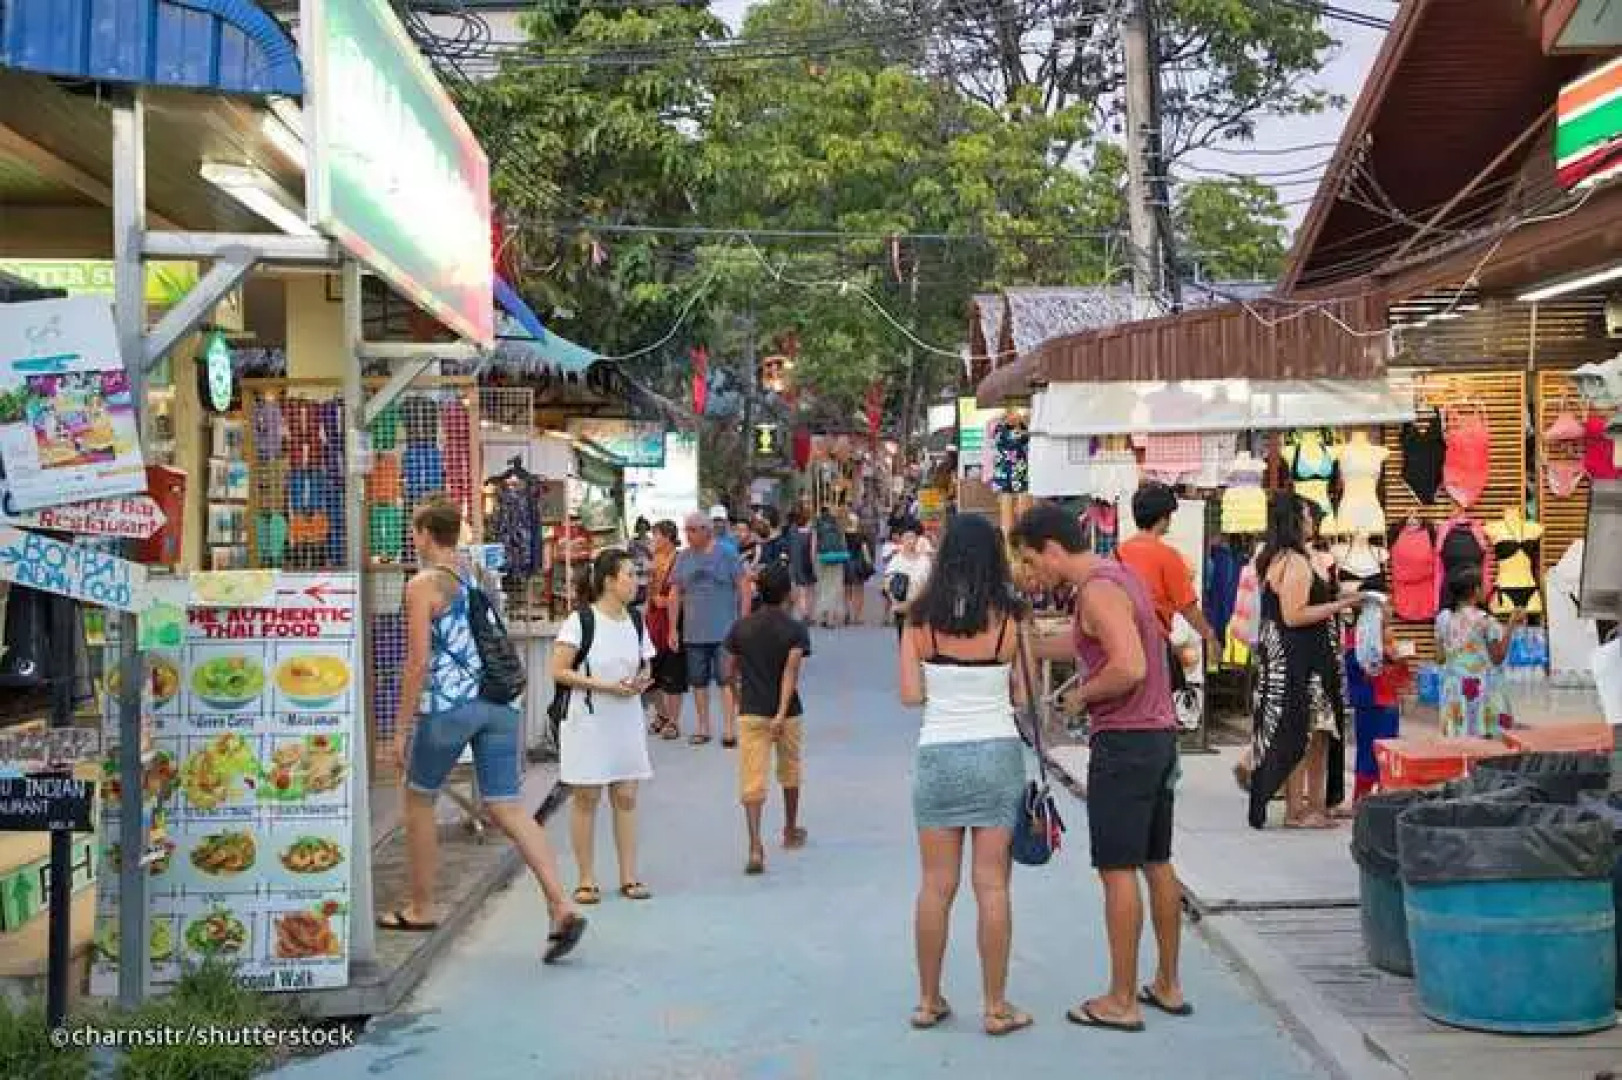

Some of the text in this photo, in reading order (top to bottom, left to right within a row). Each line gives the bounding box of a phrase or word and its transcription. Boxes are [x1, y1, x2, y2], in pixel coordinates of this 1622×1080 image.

[187, 607, 353, 624] HE AUTHENTIC
[204, 623, 321, 639] THAI FOOD
[25, 778, 85, 799] INDIAN
